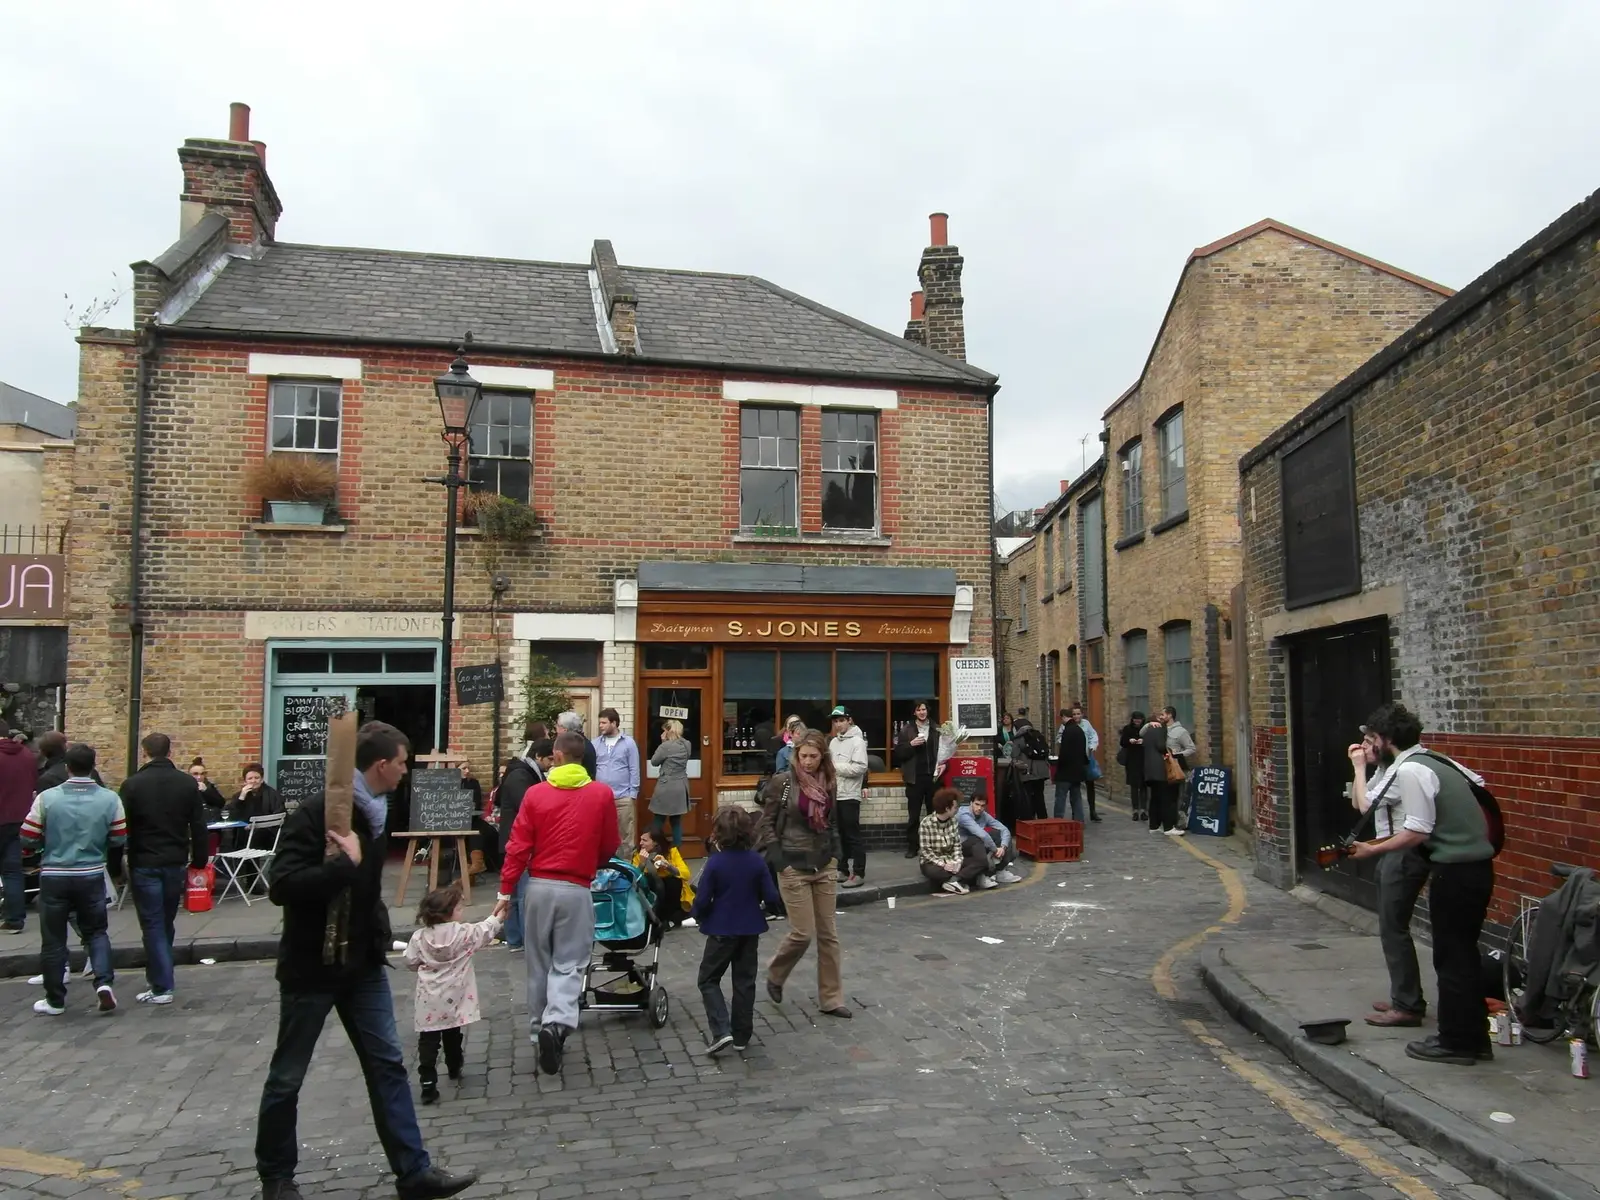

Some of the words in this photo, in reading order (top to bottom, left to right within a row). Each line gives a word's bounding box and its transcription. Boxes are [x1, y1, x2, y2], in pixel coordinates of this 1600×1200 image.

[650, 622, 714, 637] Dairymen
[878, 622, 933, 635] Provisions
[955, 659, 990, 670] CHEESE
[664, 708, 684, 717] OPEN
[960, 759, 978, 767] JONES
[1199, 768, 1225, 778] JONES
[1197, 780, 1225, 796] CAFÉ
